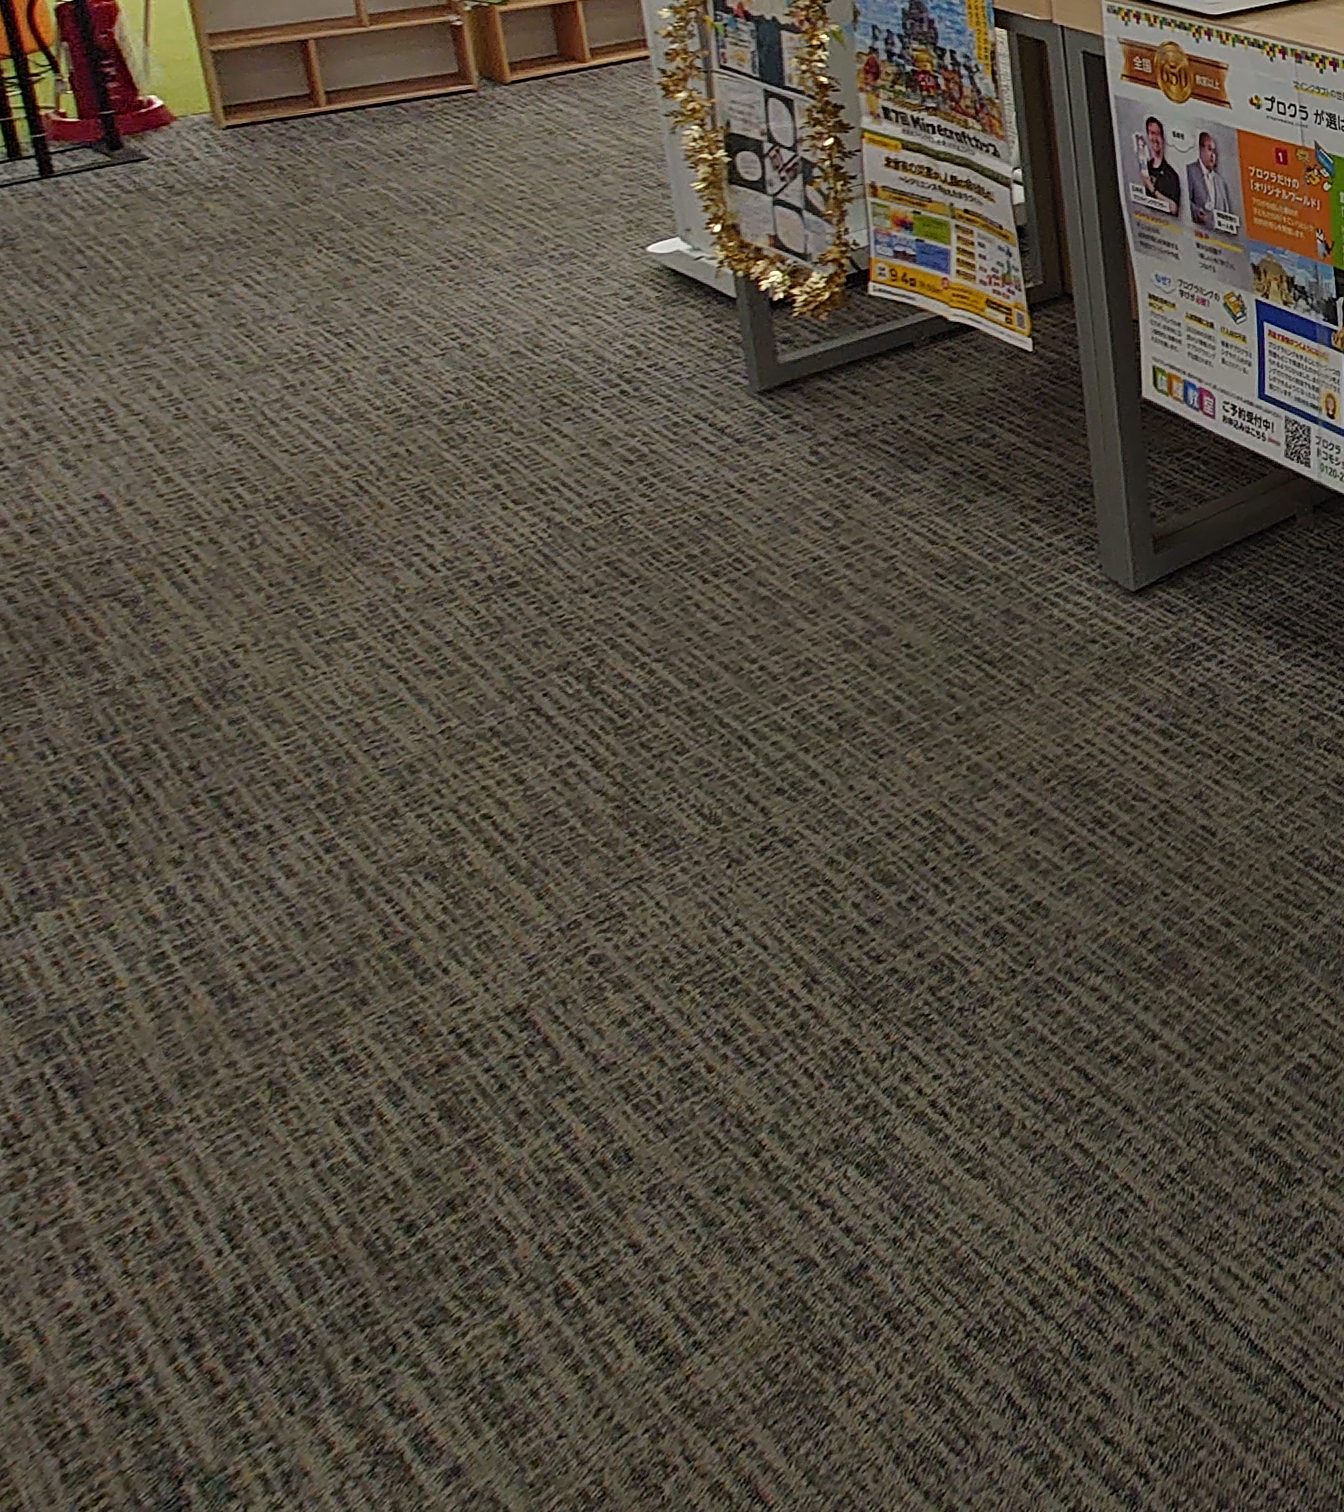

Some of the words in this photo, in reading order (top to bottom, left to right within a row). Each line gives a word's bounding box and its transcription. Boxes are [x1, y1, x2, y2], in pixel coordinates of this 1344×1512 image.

[1133, 56, 1152, 73] 全国
[1160, 64, 1188, 89] 650
[1264, 96, 1310, 121] プロクラ
[1248, 166, 1300, 189] プロクラだけの
[1221, 399, 1275, 434] ご予約受付中!
[1221, 415, 1267, 442] お申込みはこちら
[1315, 435, 1341, 455] プロクラ
